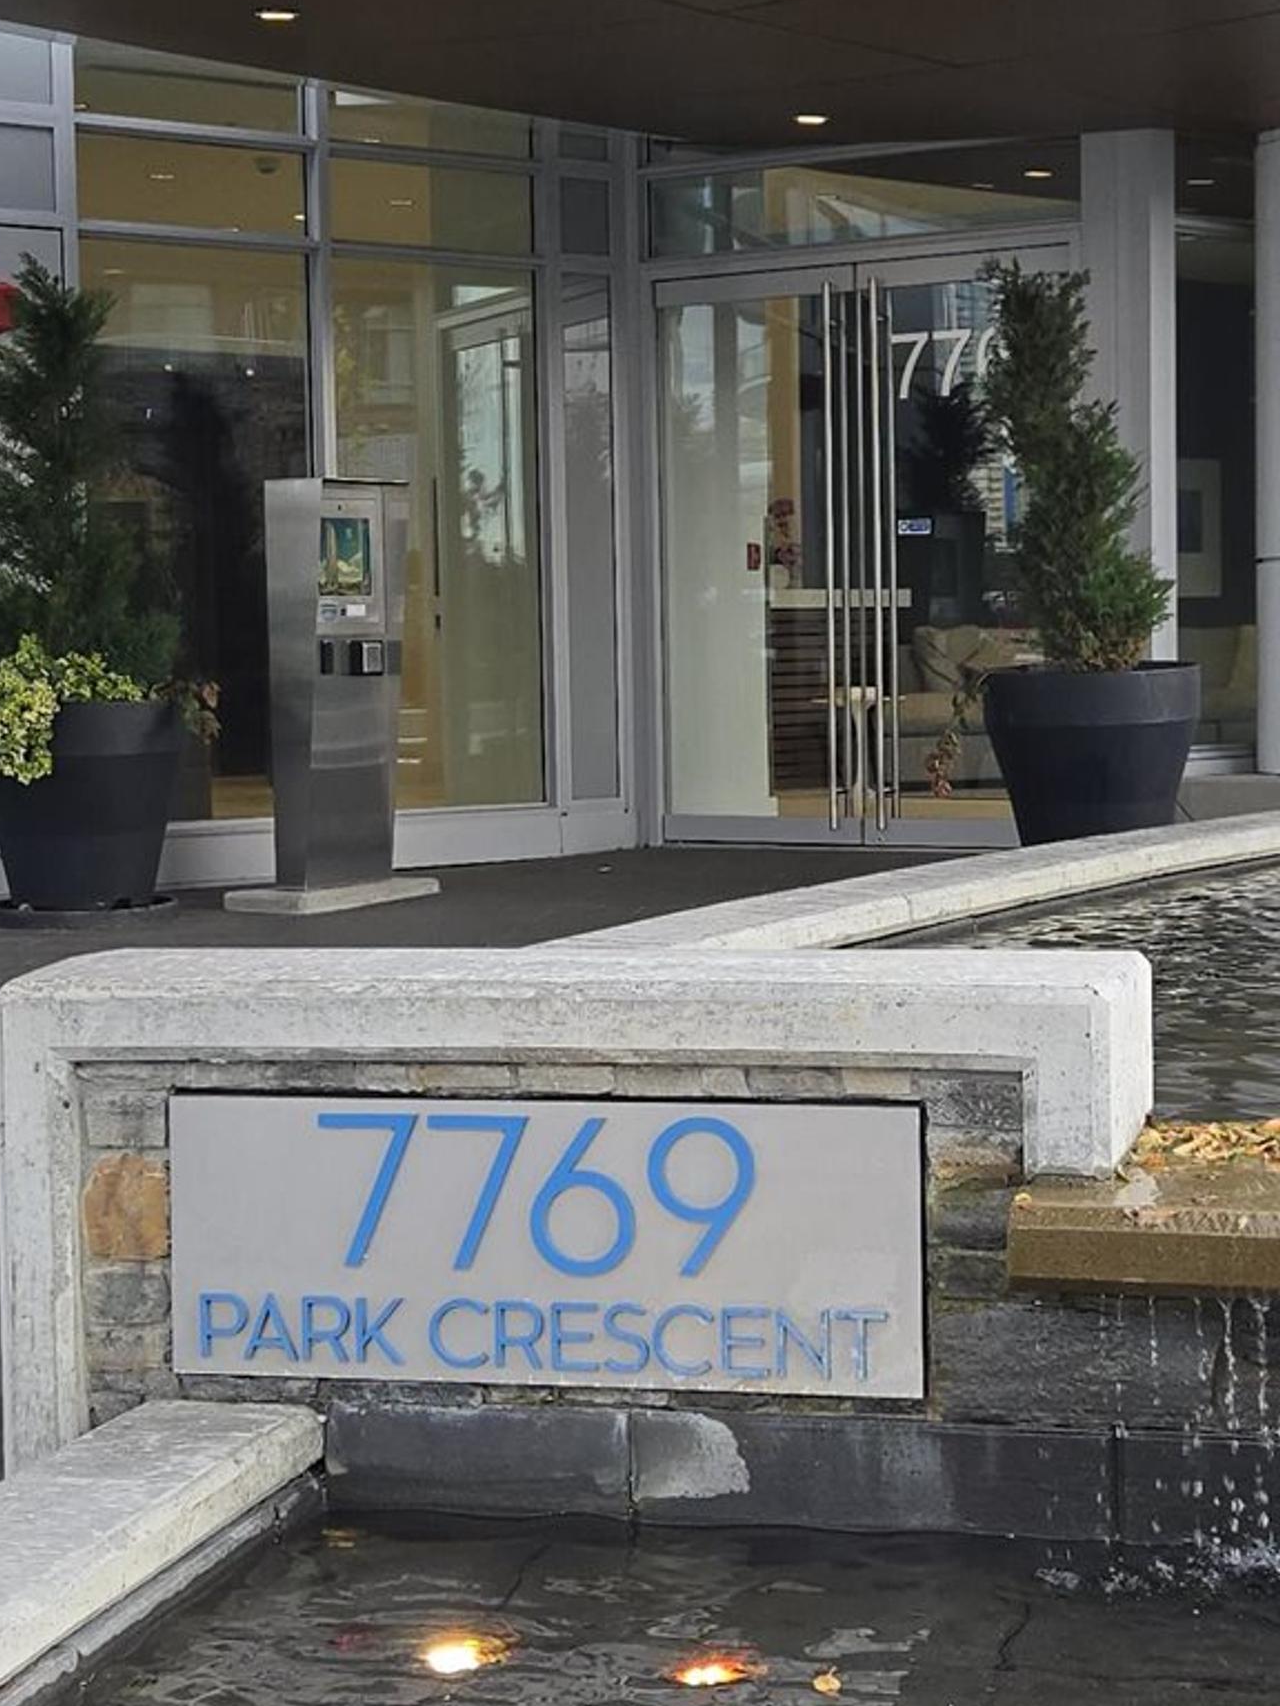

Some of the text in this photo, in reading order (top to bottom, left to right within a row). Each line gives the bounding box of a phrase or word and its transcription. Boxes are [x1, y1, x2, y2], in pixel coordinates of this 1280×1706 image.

[317, 1112, 756, 1278] 7769
[197, 1292, 889, 1382] PARK CRESCENT
